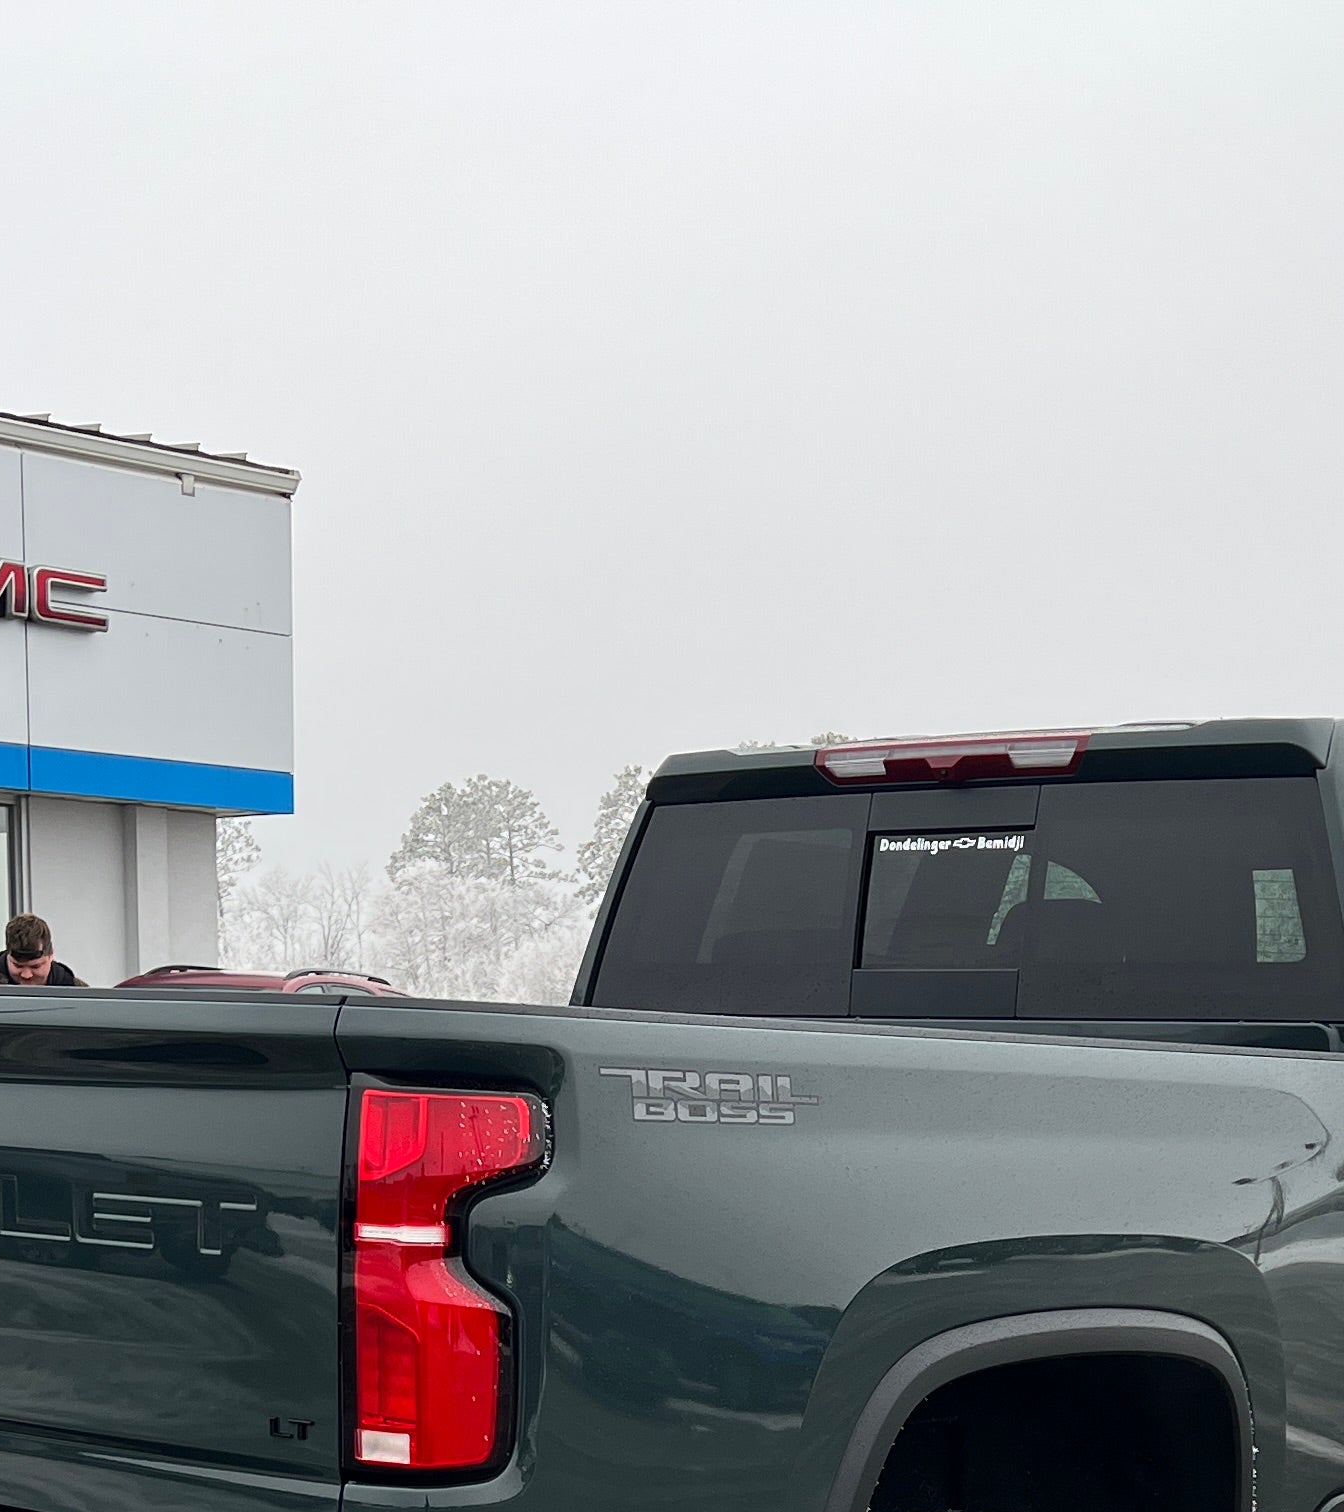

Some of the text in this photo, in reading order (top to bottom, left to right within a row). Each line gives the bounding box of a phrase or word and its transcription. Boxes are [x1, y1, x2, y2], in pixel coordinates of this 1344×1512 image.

[879, 834, 1025, 855] Dondelinger Bemidji
[599, 1066, 819, 1105] TRAIL
[632, 1099, 795, 1125] BOSS
[268, 1416, 316, 1441] LT
